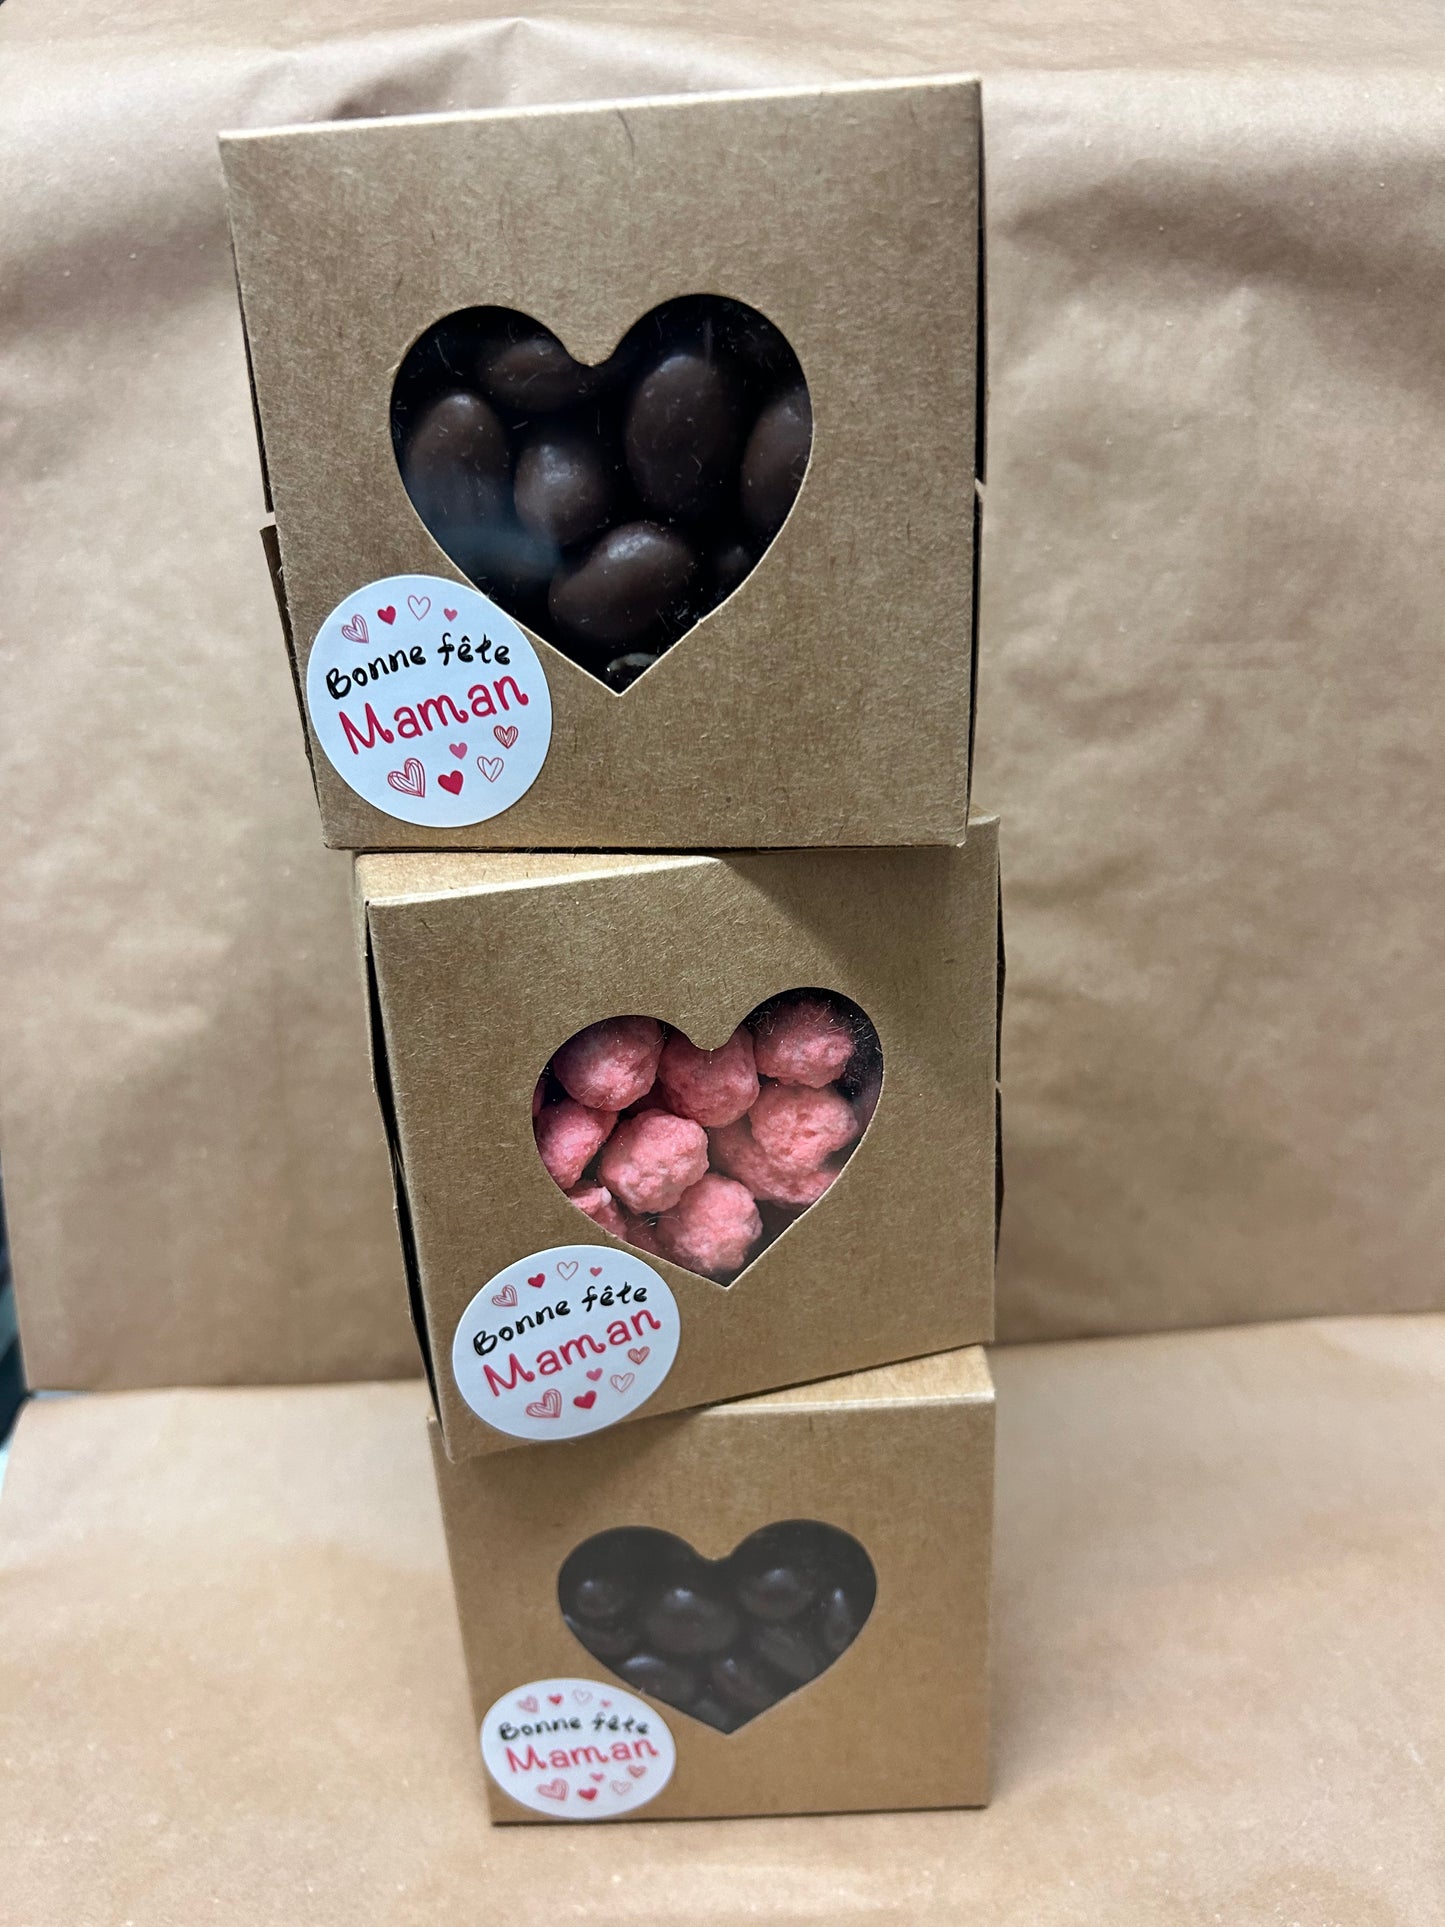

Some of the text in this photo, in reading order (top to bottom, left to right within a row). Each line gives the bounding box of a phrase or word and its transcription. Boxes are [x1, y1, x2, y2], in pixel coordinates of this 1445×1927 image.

[325, 632, 511, 700] Bonne fête
[338, 675, 530, 755] Maman
[472, 1281, 648, 1356] Bonne fête
[482, 1309, 662, 1397] Maman
[499, 1711, 650, 1741] Bonne fête
[505, 1738, 659, 1774] Maman
